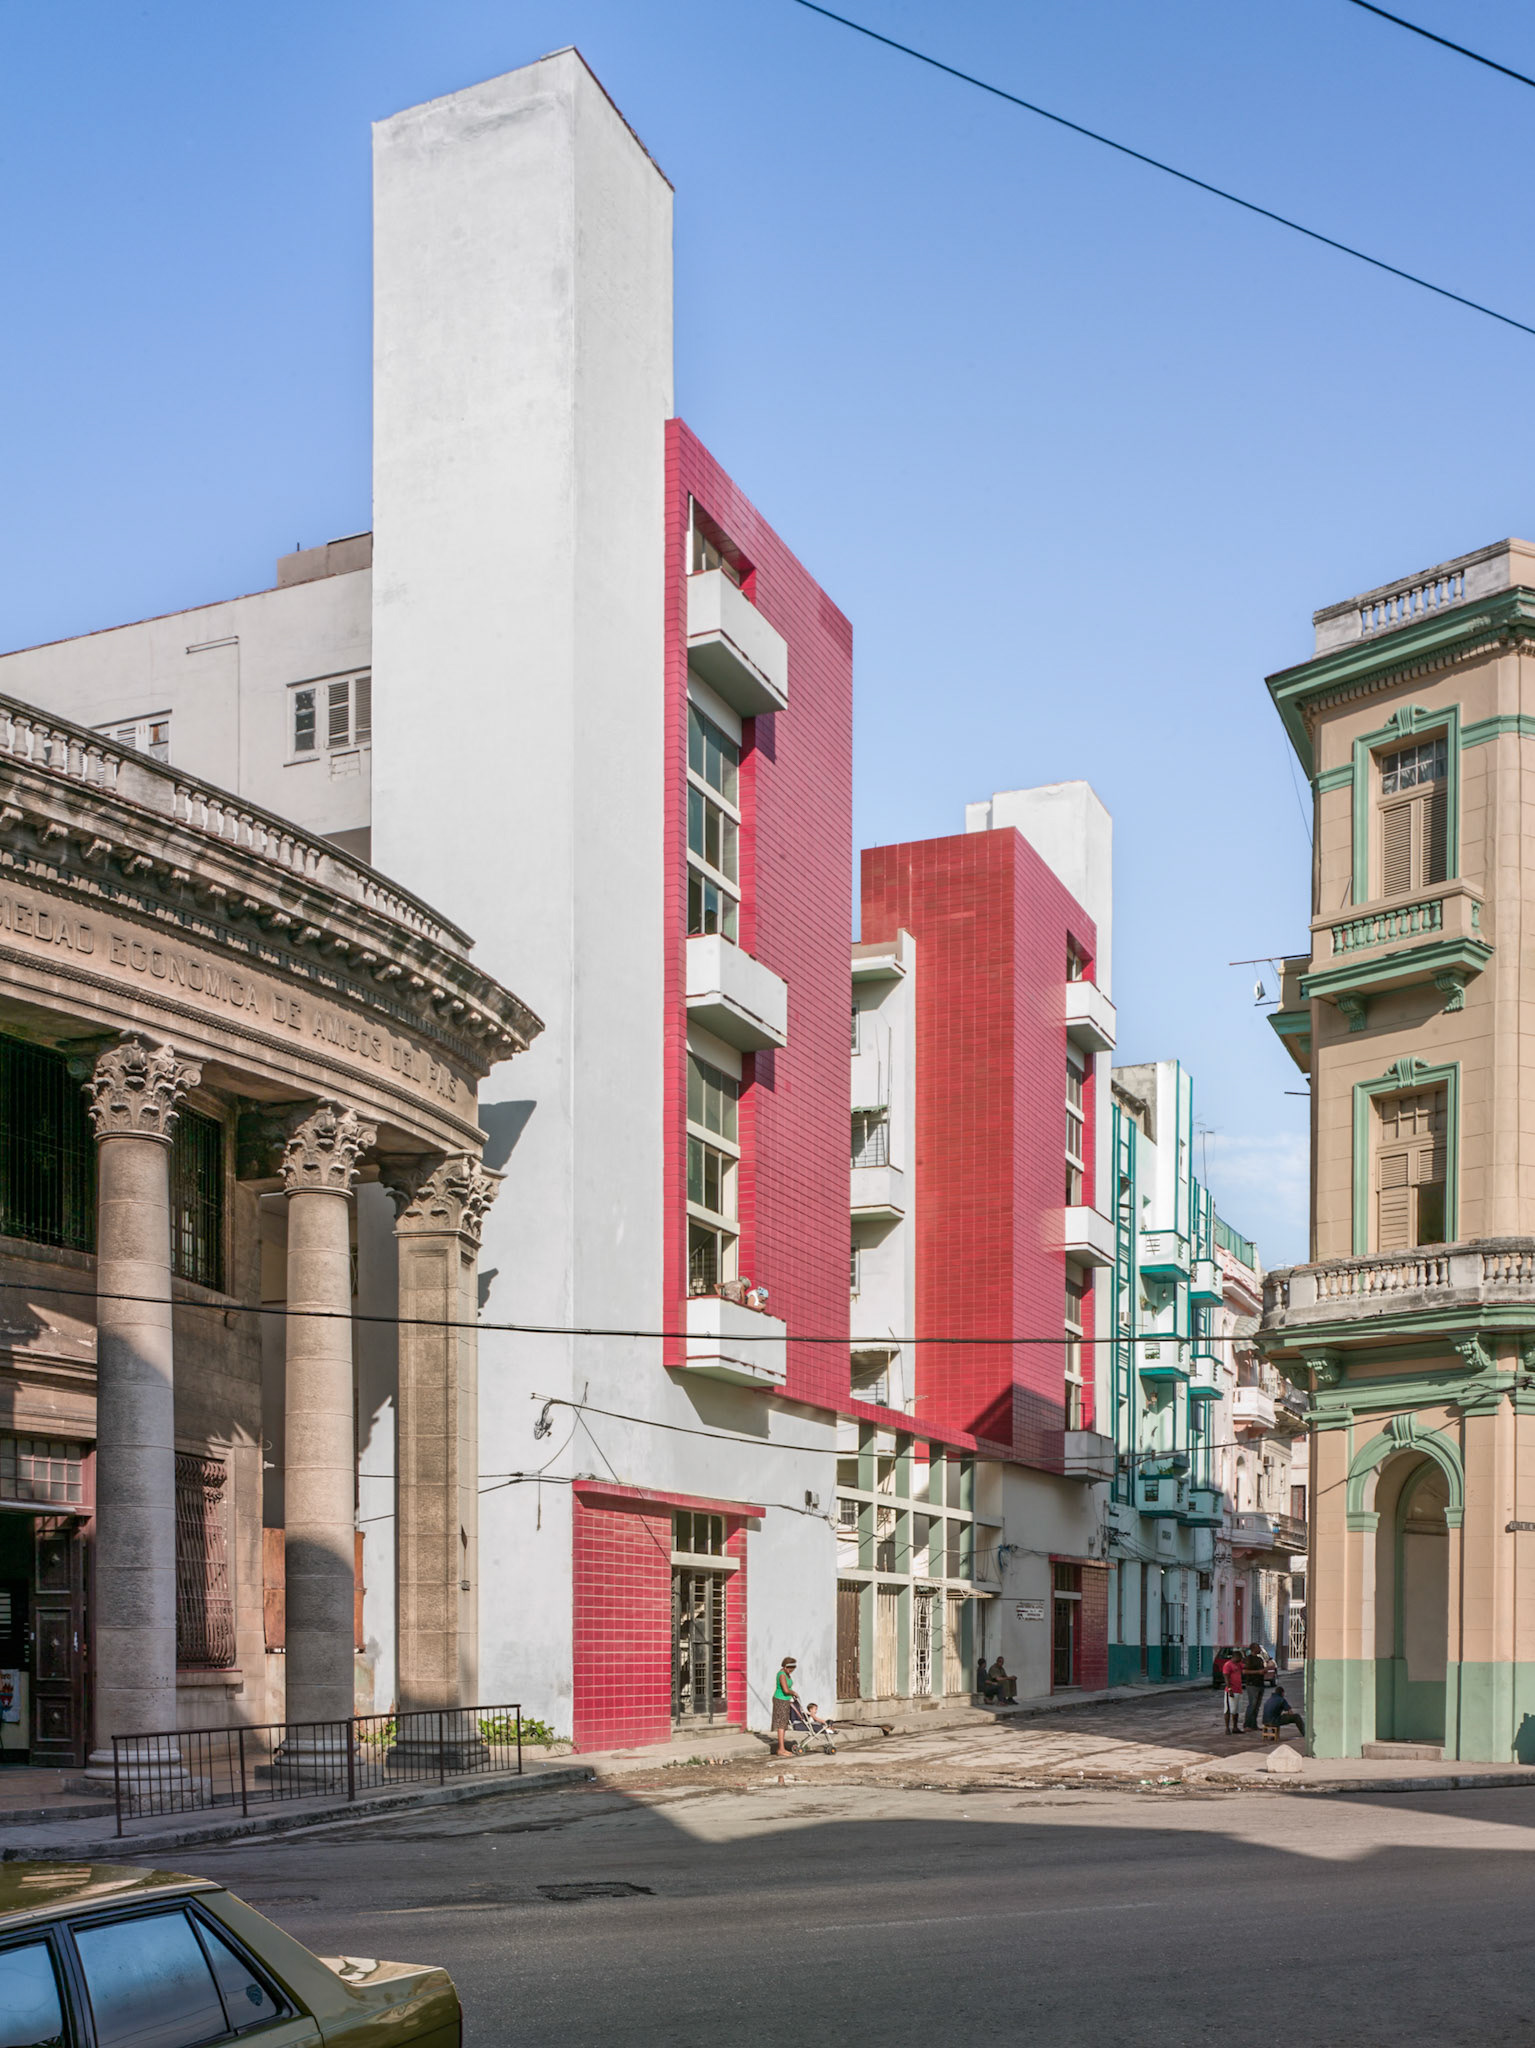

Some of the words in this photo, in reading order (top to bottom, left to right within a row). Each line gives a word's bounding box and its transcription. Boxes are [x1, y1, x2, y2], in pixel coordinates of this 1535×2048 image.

[0, 895, 95, 955] IEDAD
[272, 992, 302, 1031] DE
[312, 1009, 382, 1063] AMIGOS
[391, 1043, 421, 1083] DEL
